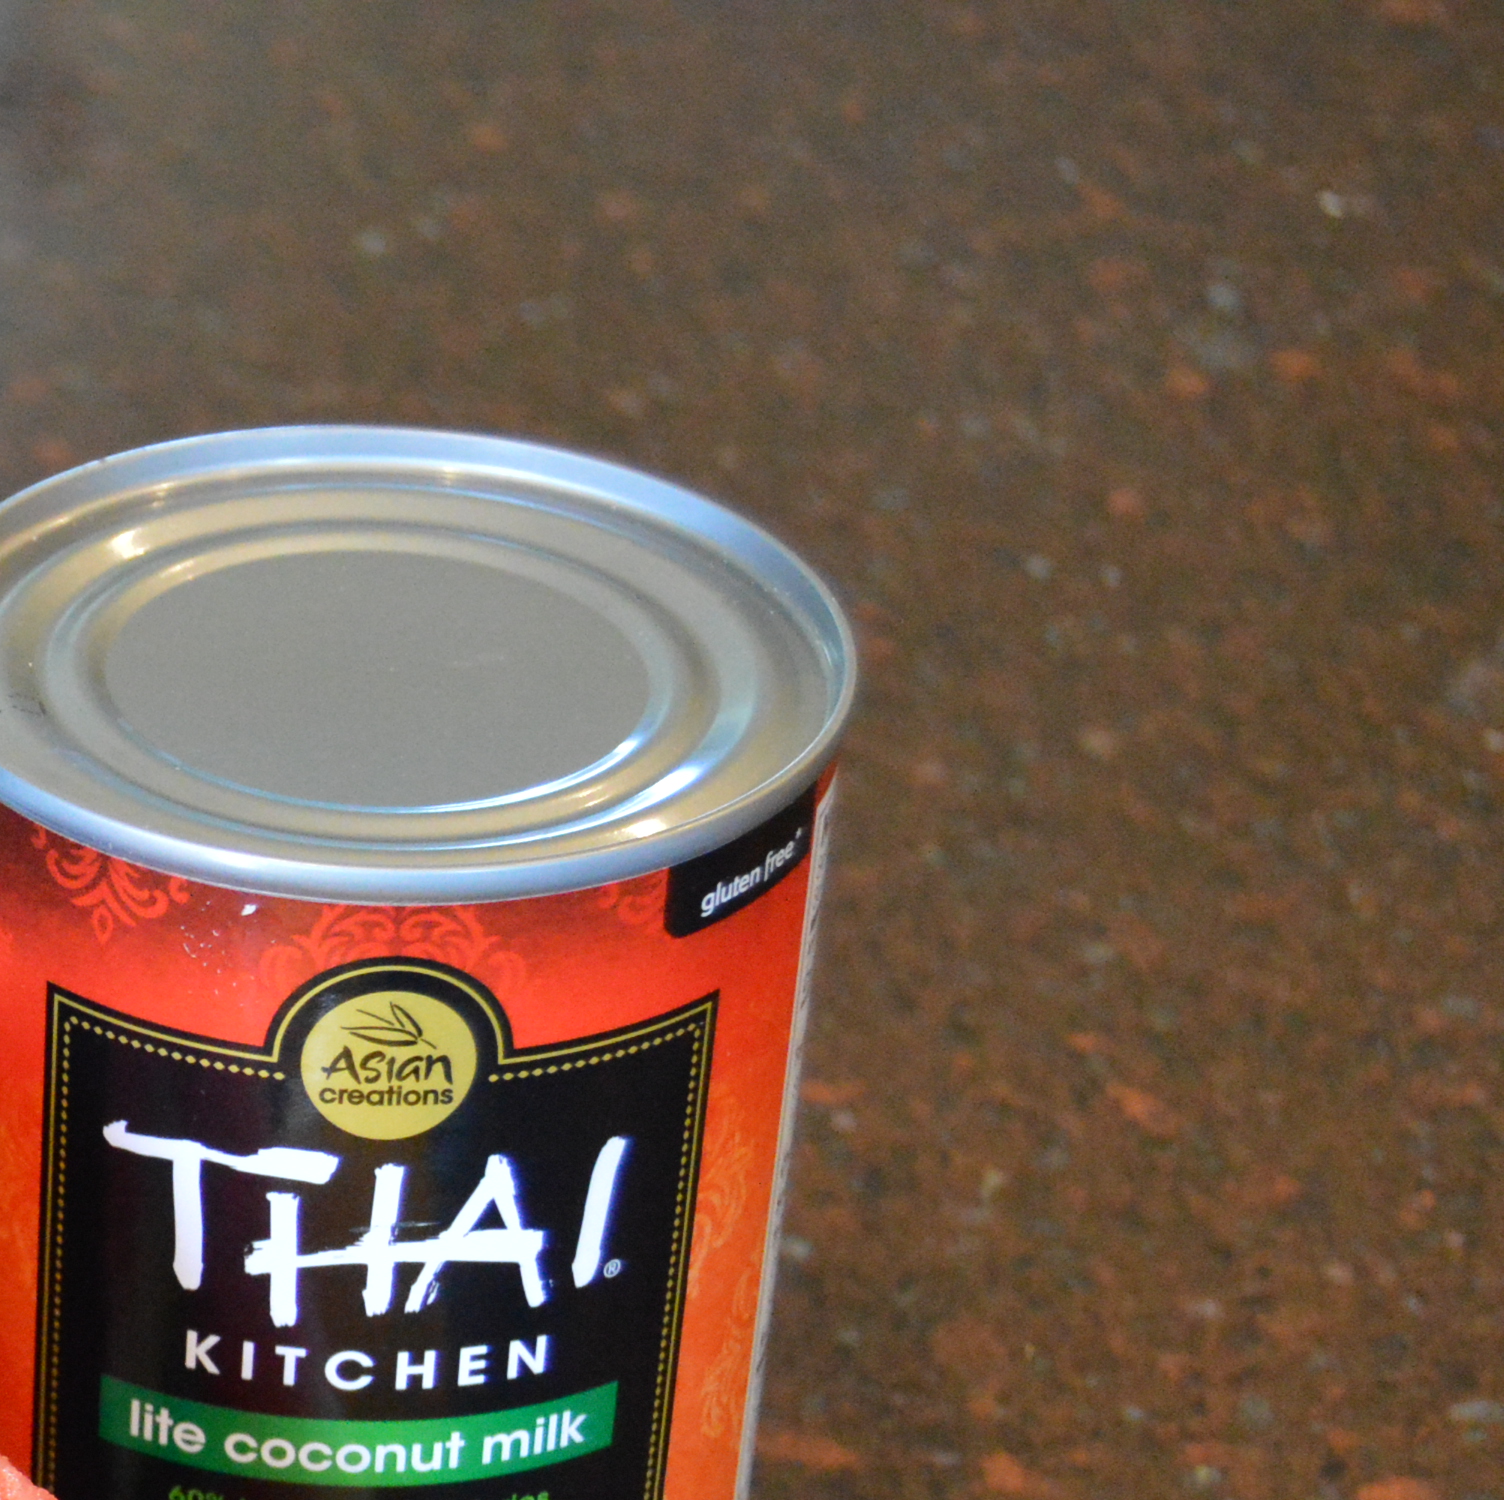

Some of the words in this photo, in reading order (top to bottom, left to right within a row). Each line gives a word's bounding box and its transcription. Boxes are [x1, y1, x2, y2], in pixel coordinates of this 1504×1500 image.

[701, 866, 762, 918] gluten
[321, 1044, 453, 1085] Asian
[319, 1085, 453, 1107] creations
[186, 1329, 549, 1391] KITCHEN
[130, 1399, 206, 1453] lite
[223, 1431, 466, 1474] coconut
[481, 1409, 588, 1466] milk
